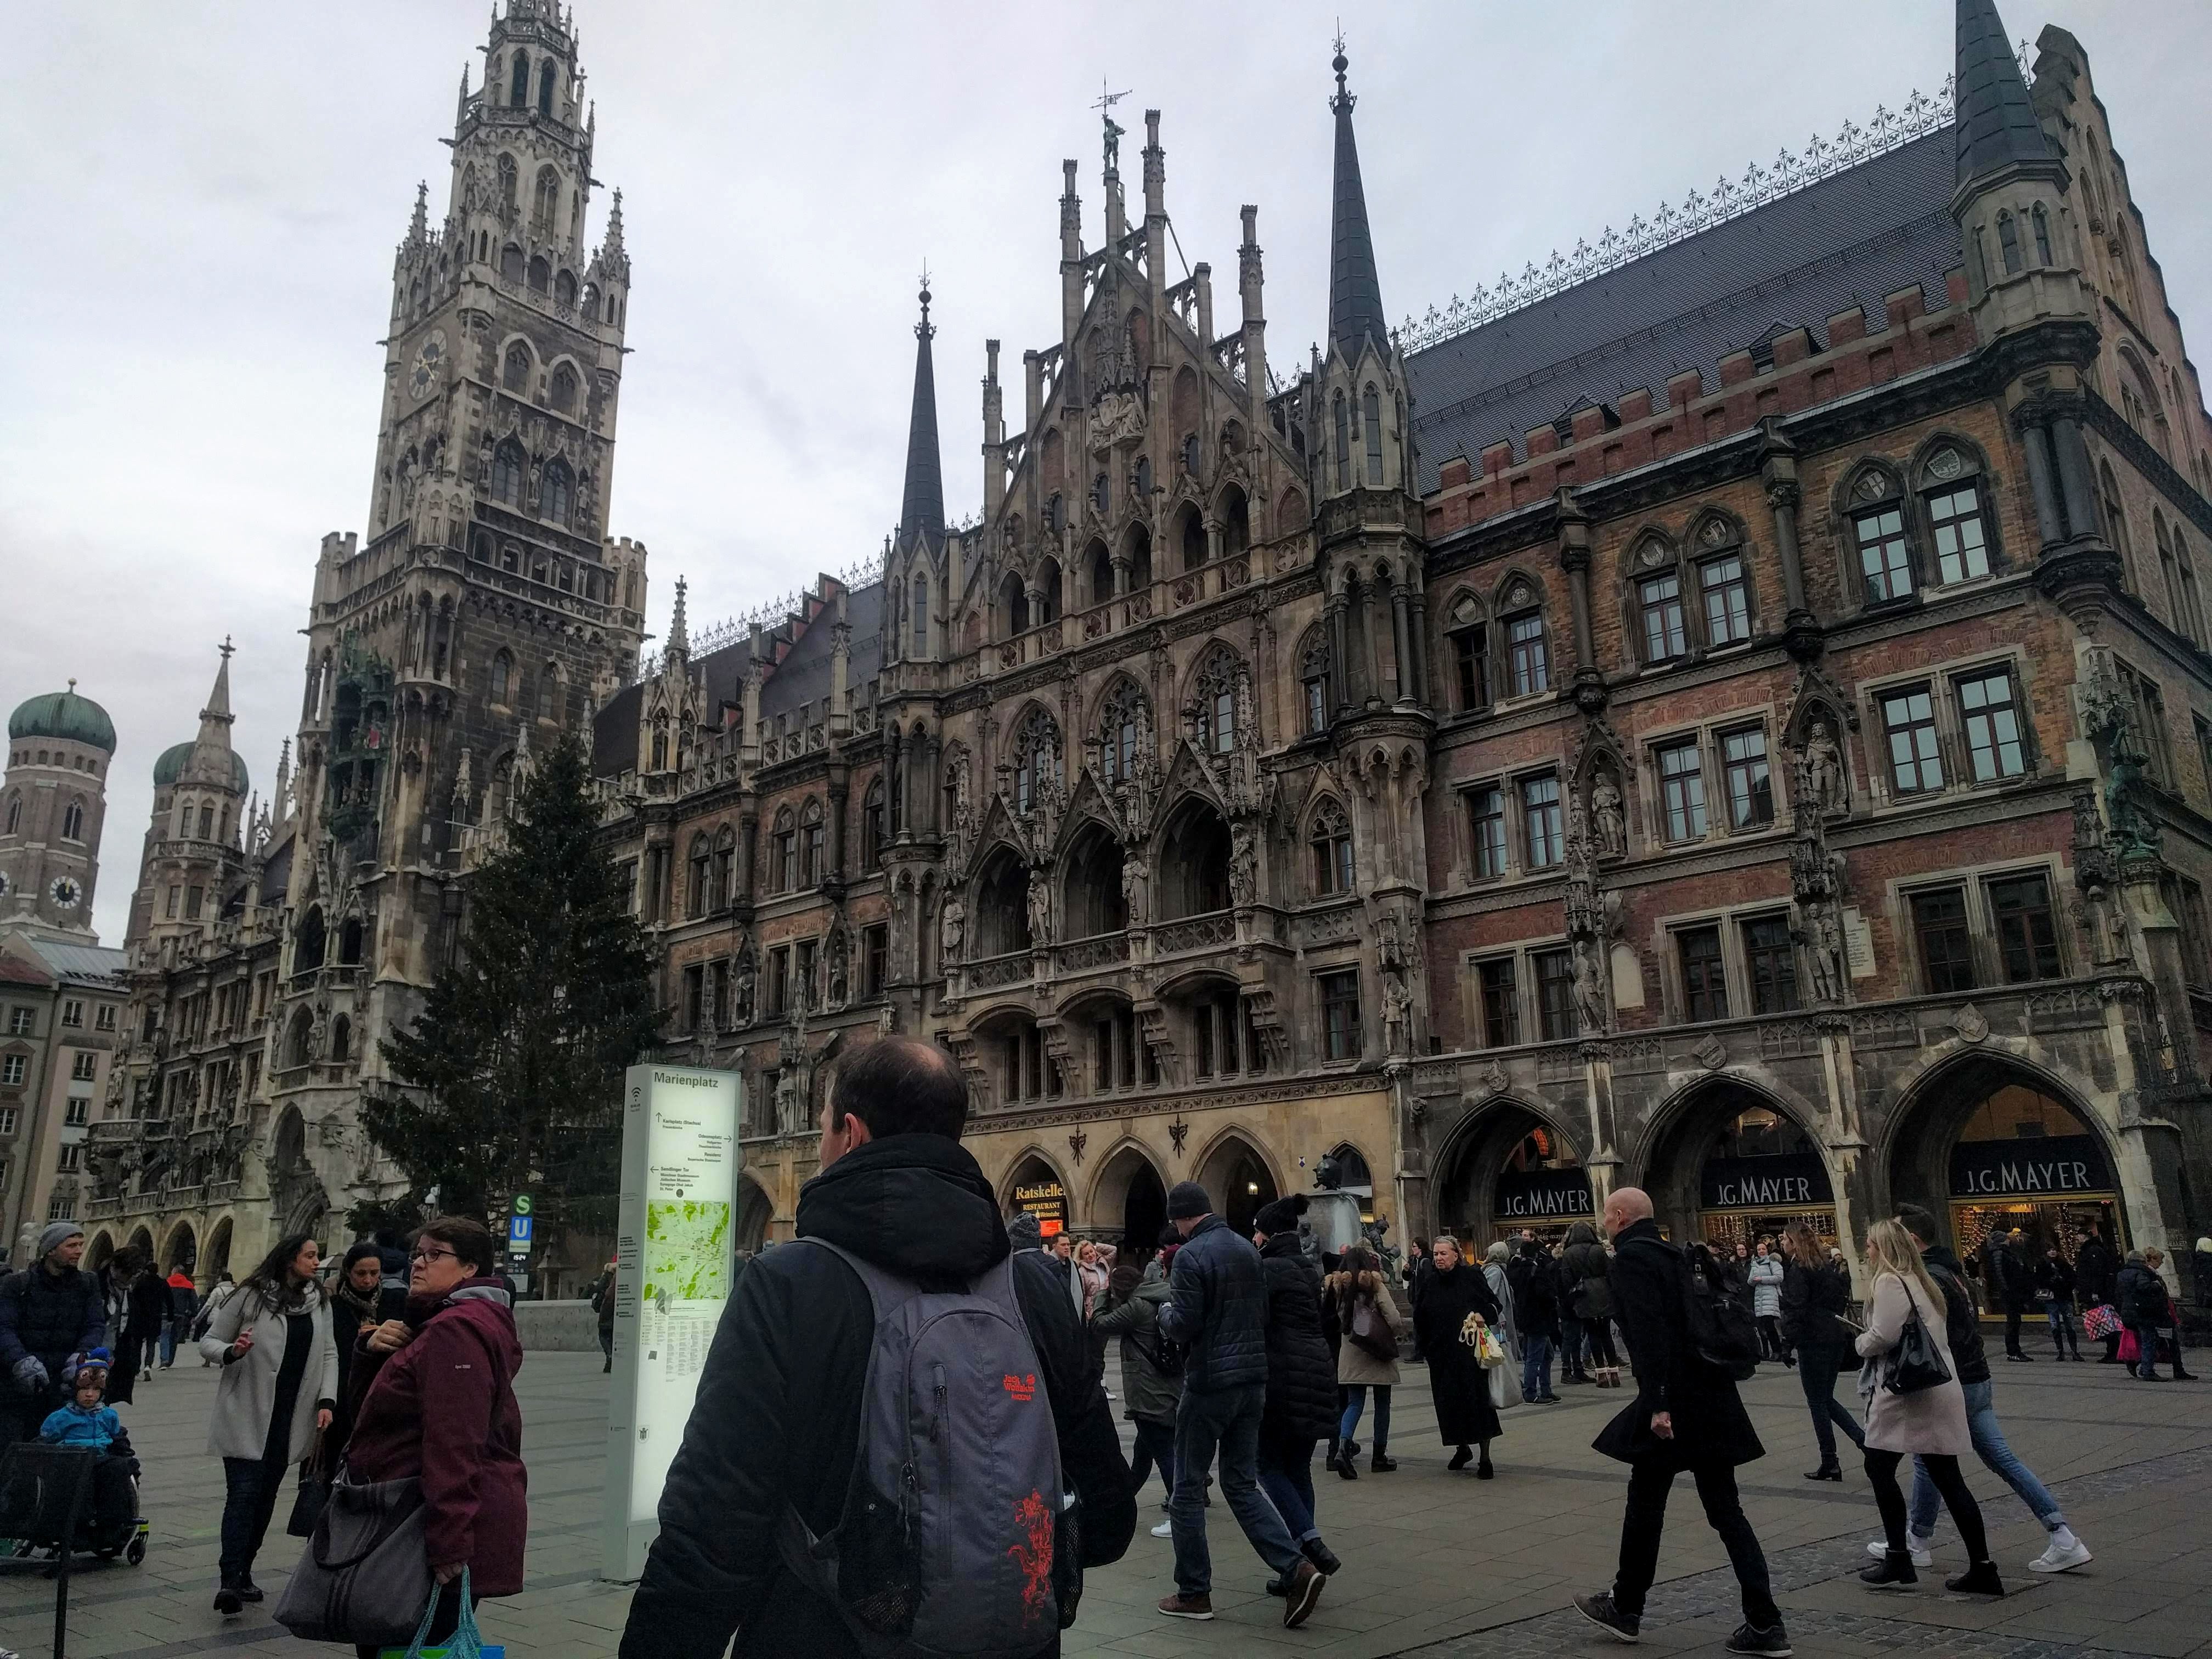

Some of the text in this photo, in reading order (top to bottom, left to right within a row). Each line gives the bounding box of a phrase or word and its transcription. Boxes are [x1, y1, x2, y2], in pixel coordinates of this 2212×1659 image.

[654, 1071, 719, 1088] Marienplatz
[516, 1195, 531, 1215] S
[514, 1219, 528, 1238] U
[1003, 1374, 1020, 1383] Jack
